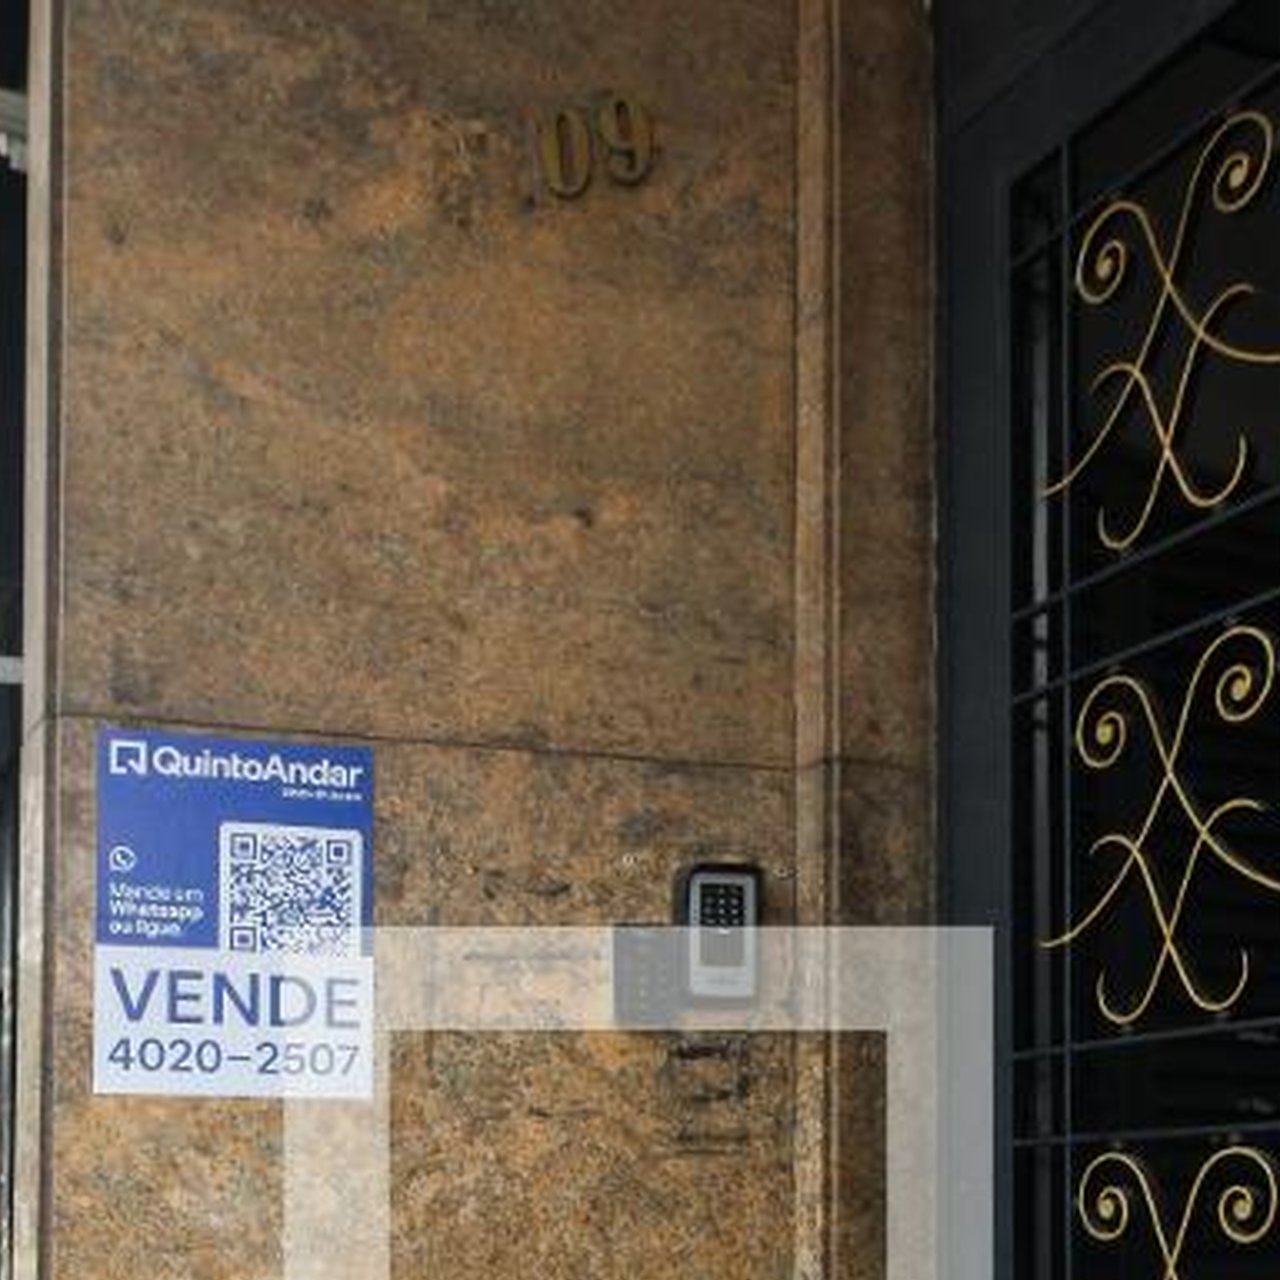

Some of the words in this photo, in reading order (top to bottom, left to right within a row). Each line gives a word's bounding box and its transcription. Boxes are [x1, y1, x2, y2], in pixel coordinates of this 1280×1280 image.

[152, 745, 363, 788] QuintoAndar
[109, 967, 361, 1029] VENDE
[108, 1037, 360, 1075] 4020-2507
